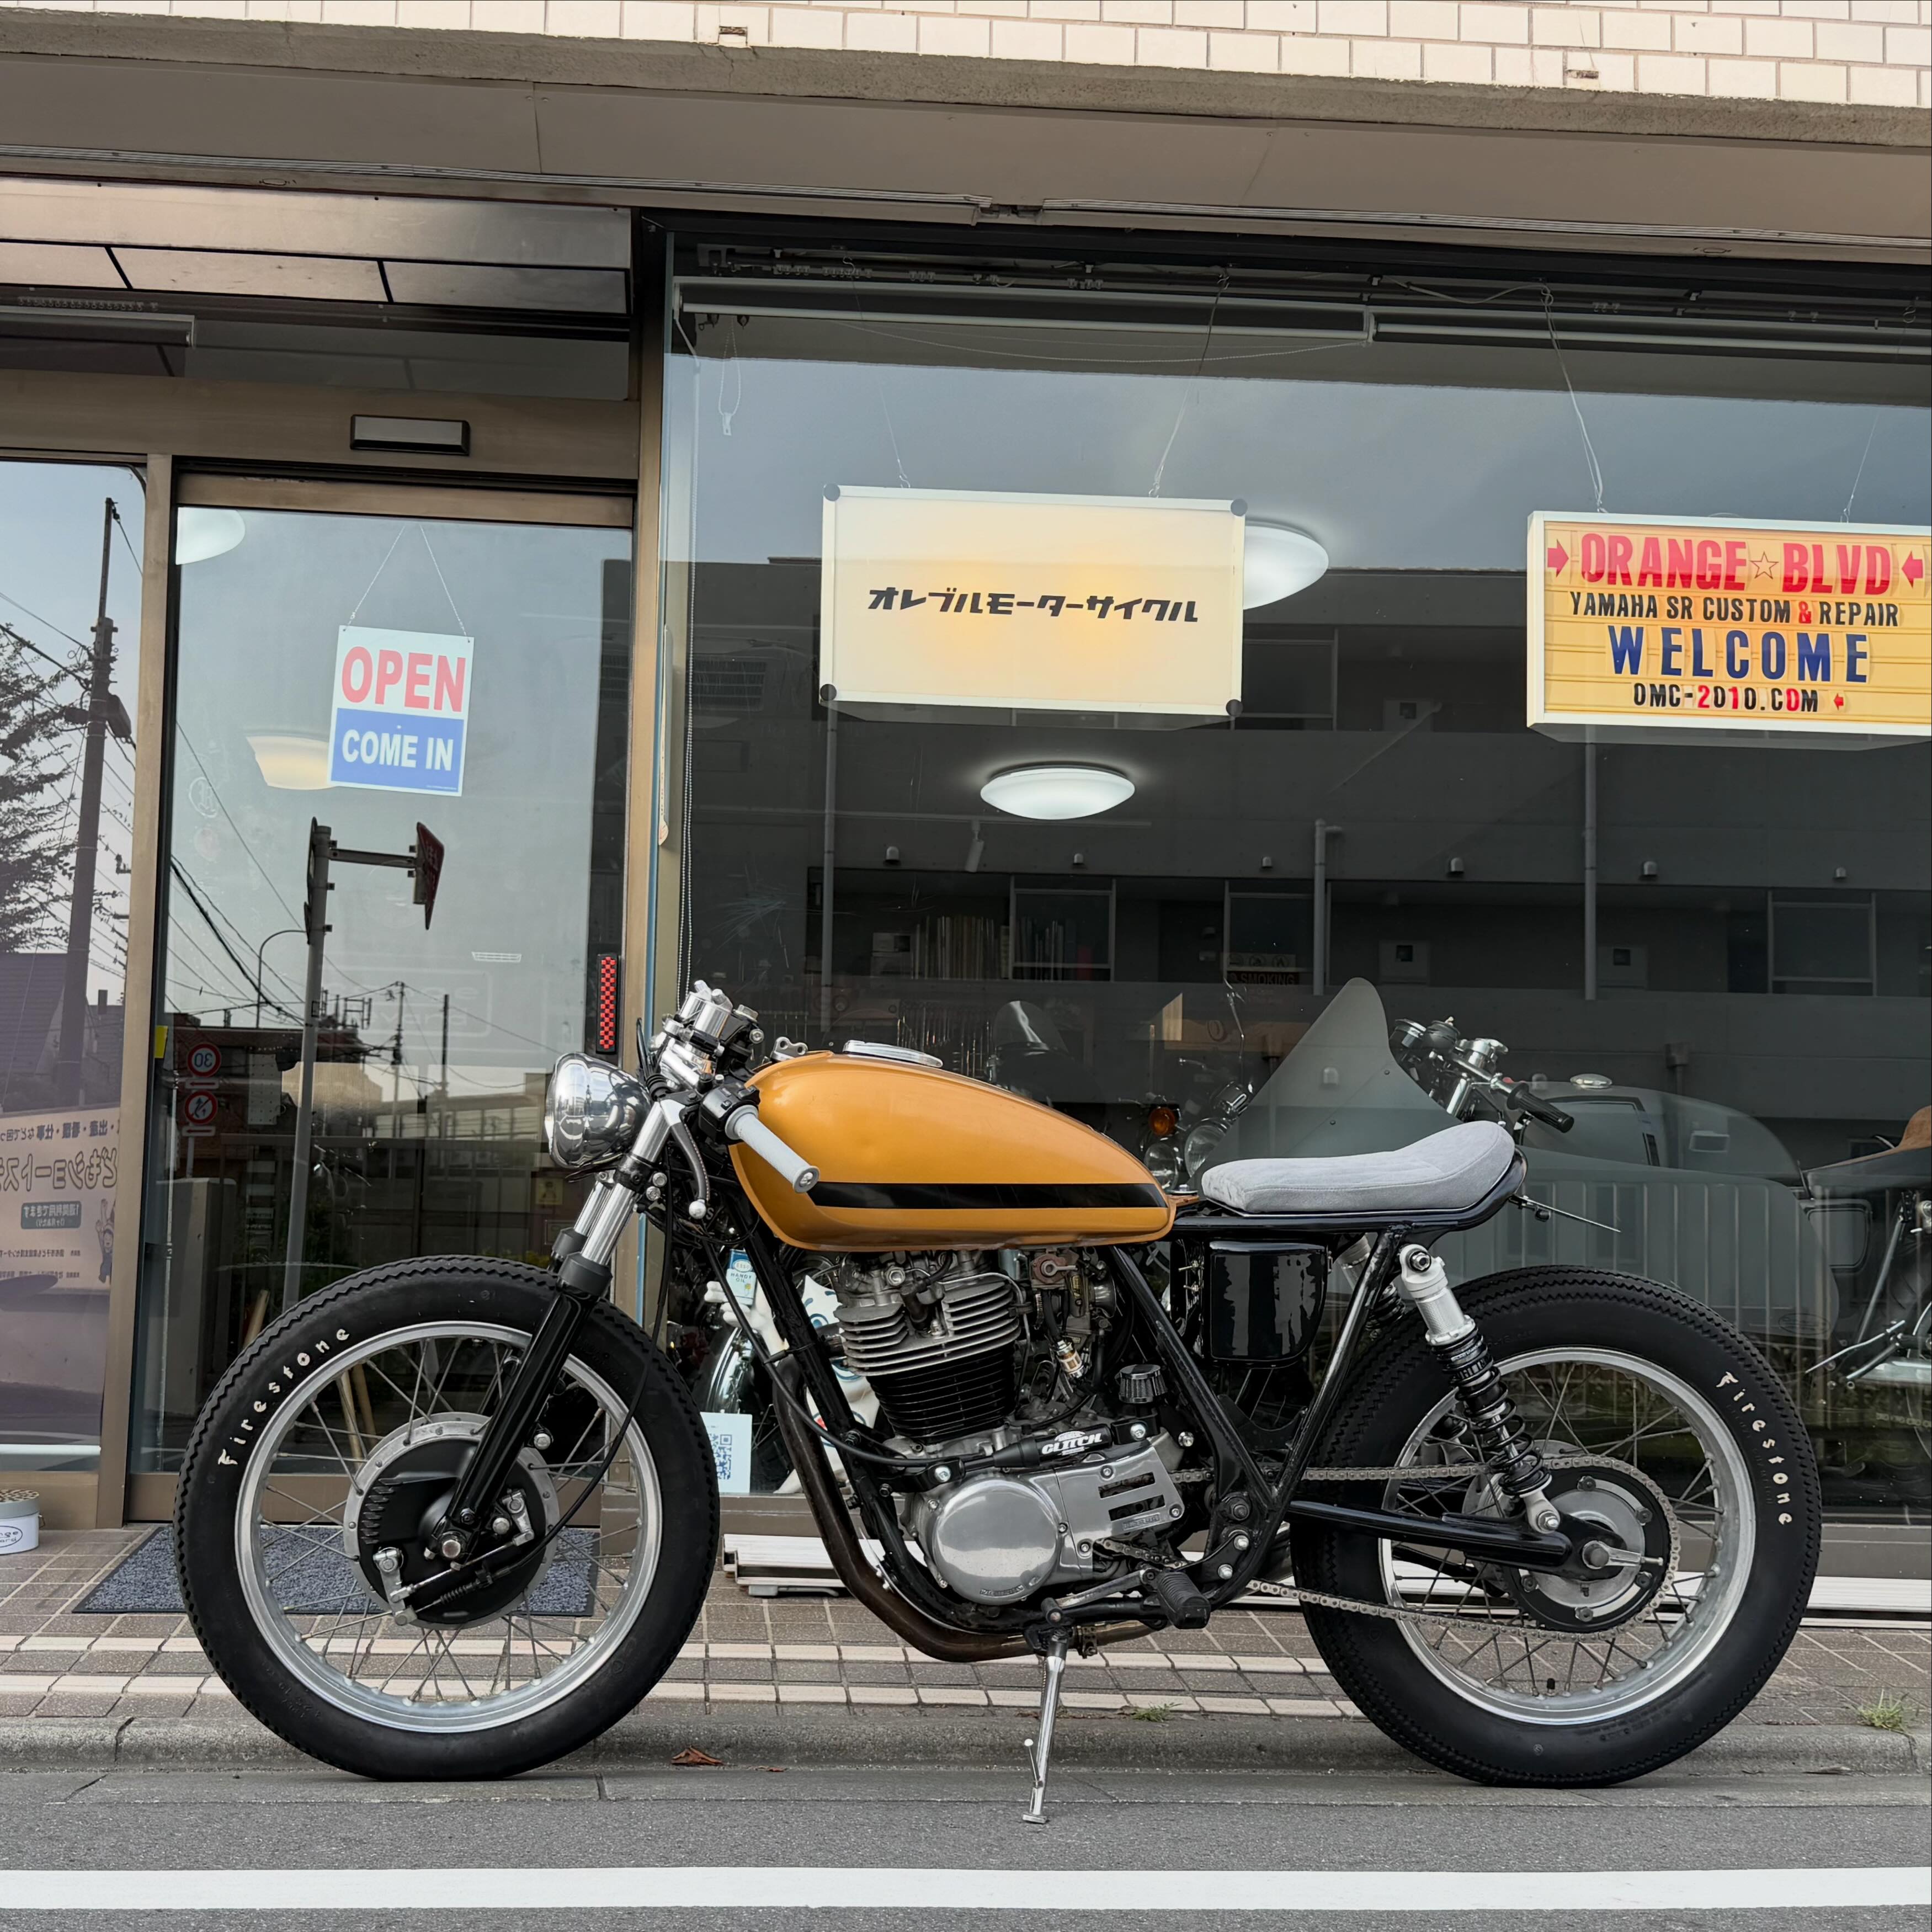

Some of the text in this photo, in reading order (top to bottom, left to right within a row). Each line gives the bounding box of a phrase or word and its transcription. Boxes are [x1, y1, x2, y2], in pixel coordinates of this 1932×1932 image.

[1580, 533, 1892, 595] ORANGE BLVD
[867, 586, 1199, 622] オレブルモーターサイクル
[1569, 590, 1899, 627] YAMAHA SR CUSTOM & REPAIR
[341, 646, 466, 712] OPEN
[1607, 624, 1869, 684] WELCOME
[1633, 683, 1819, 713] OMC-2010.COM
[342, 728, 454, 771] COME IN
[1240, 972, 1295, 985] SMOKING
[217, 1328, 350, 1465] Firestone
[1715, 1371, 1792, 1525] Firestone
